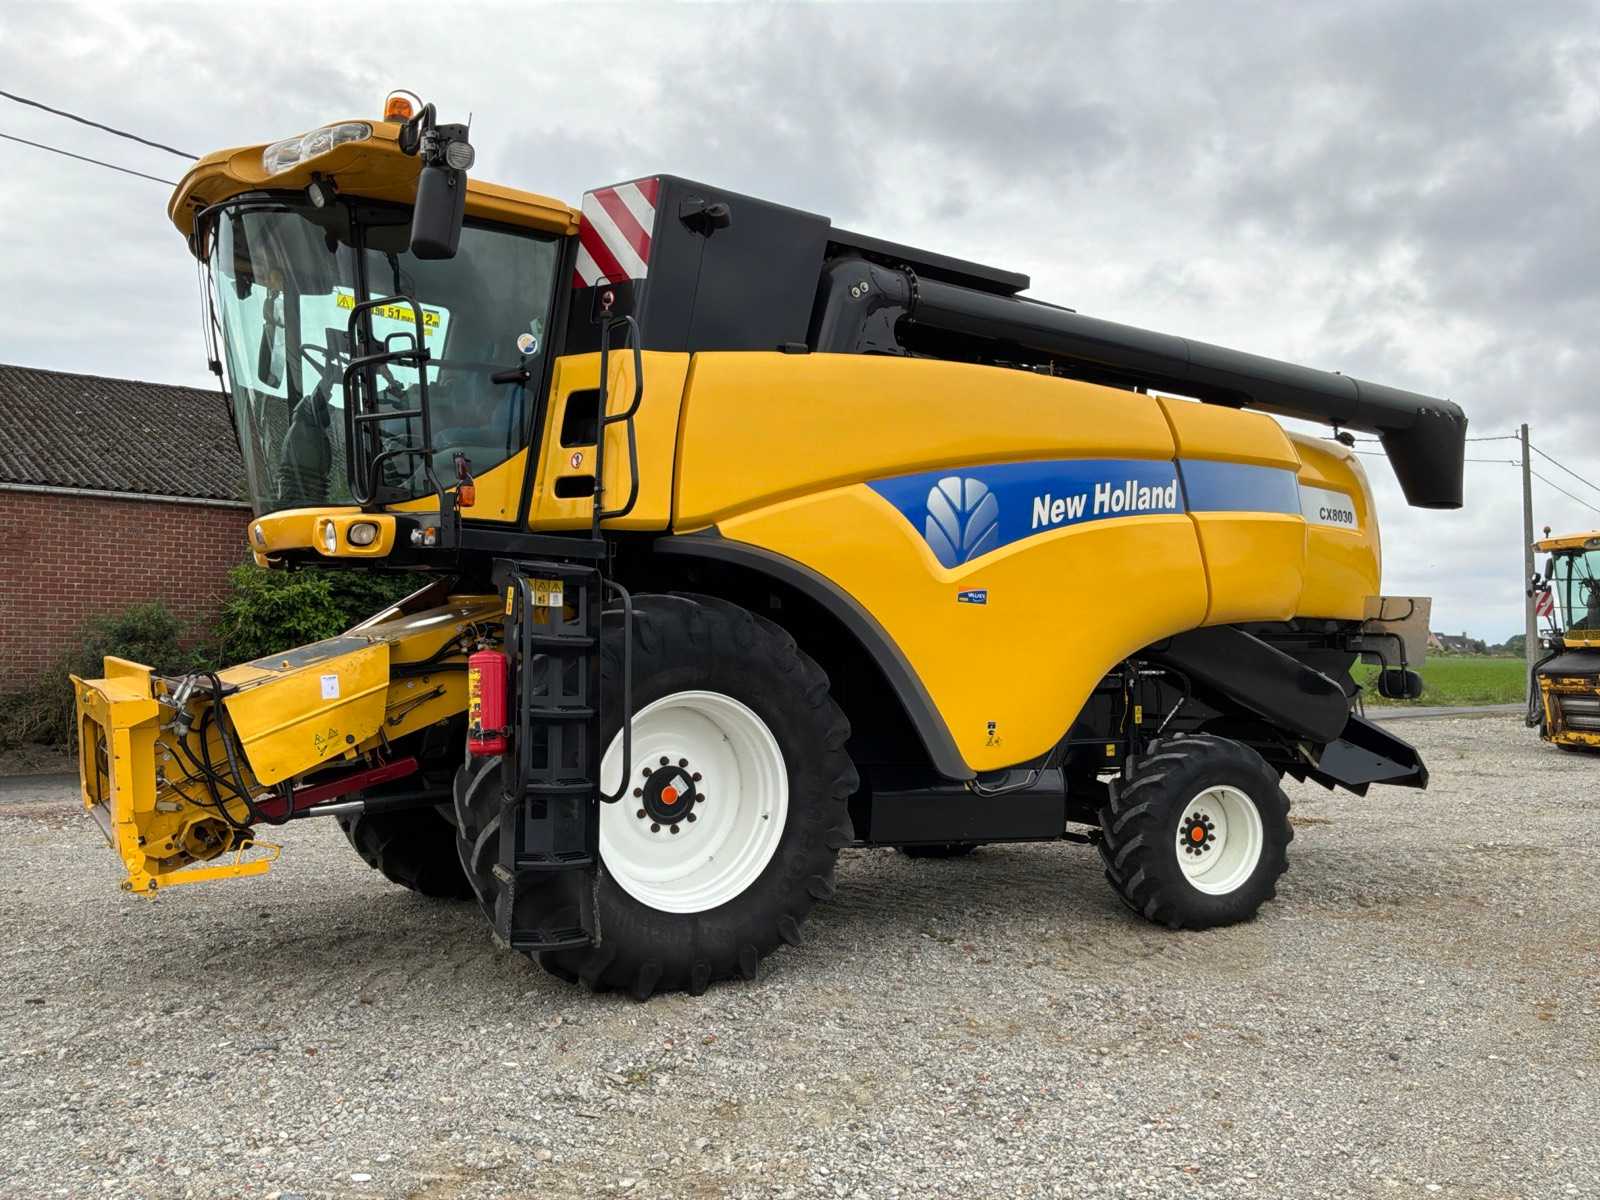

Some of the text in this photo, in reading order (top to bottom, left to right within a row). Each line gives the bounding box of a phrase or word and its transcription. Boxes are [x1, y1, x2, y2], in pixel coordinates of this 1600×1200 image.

[1031, 479, 1177, 529] New Holland
[1319, 507, 1353, 524] CX8030
